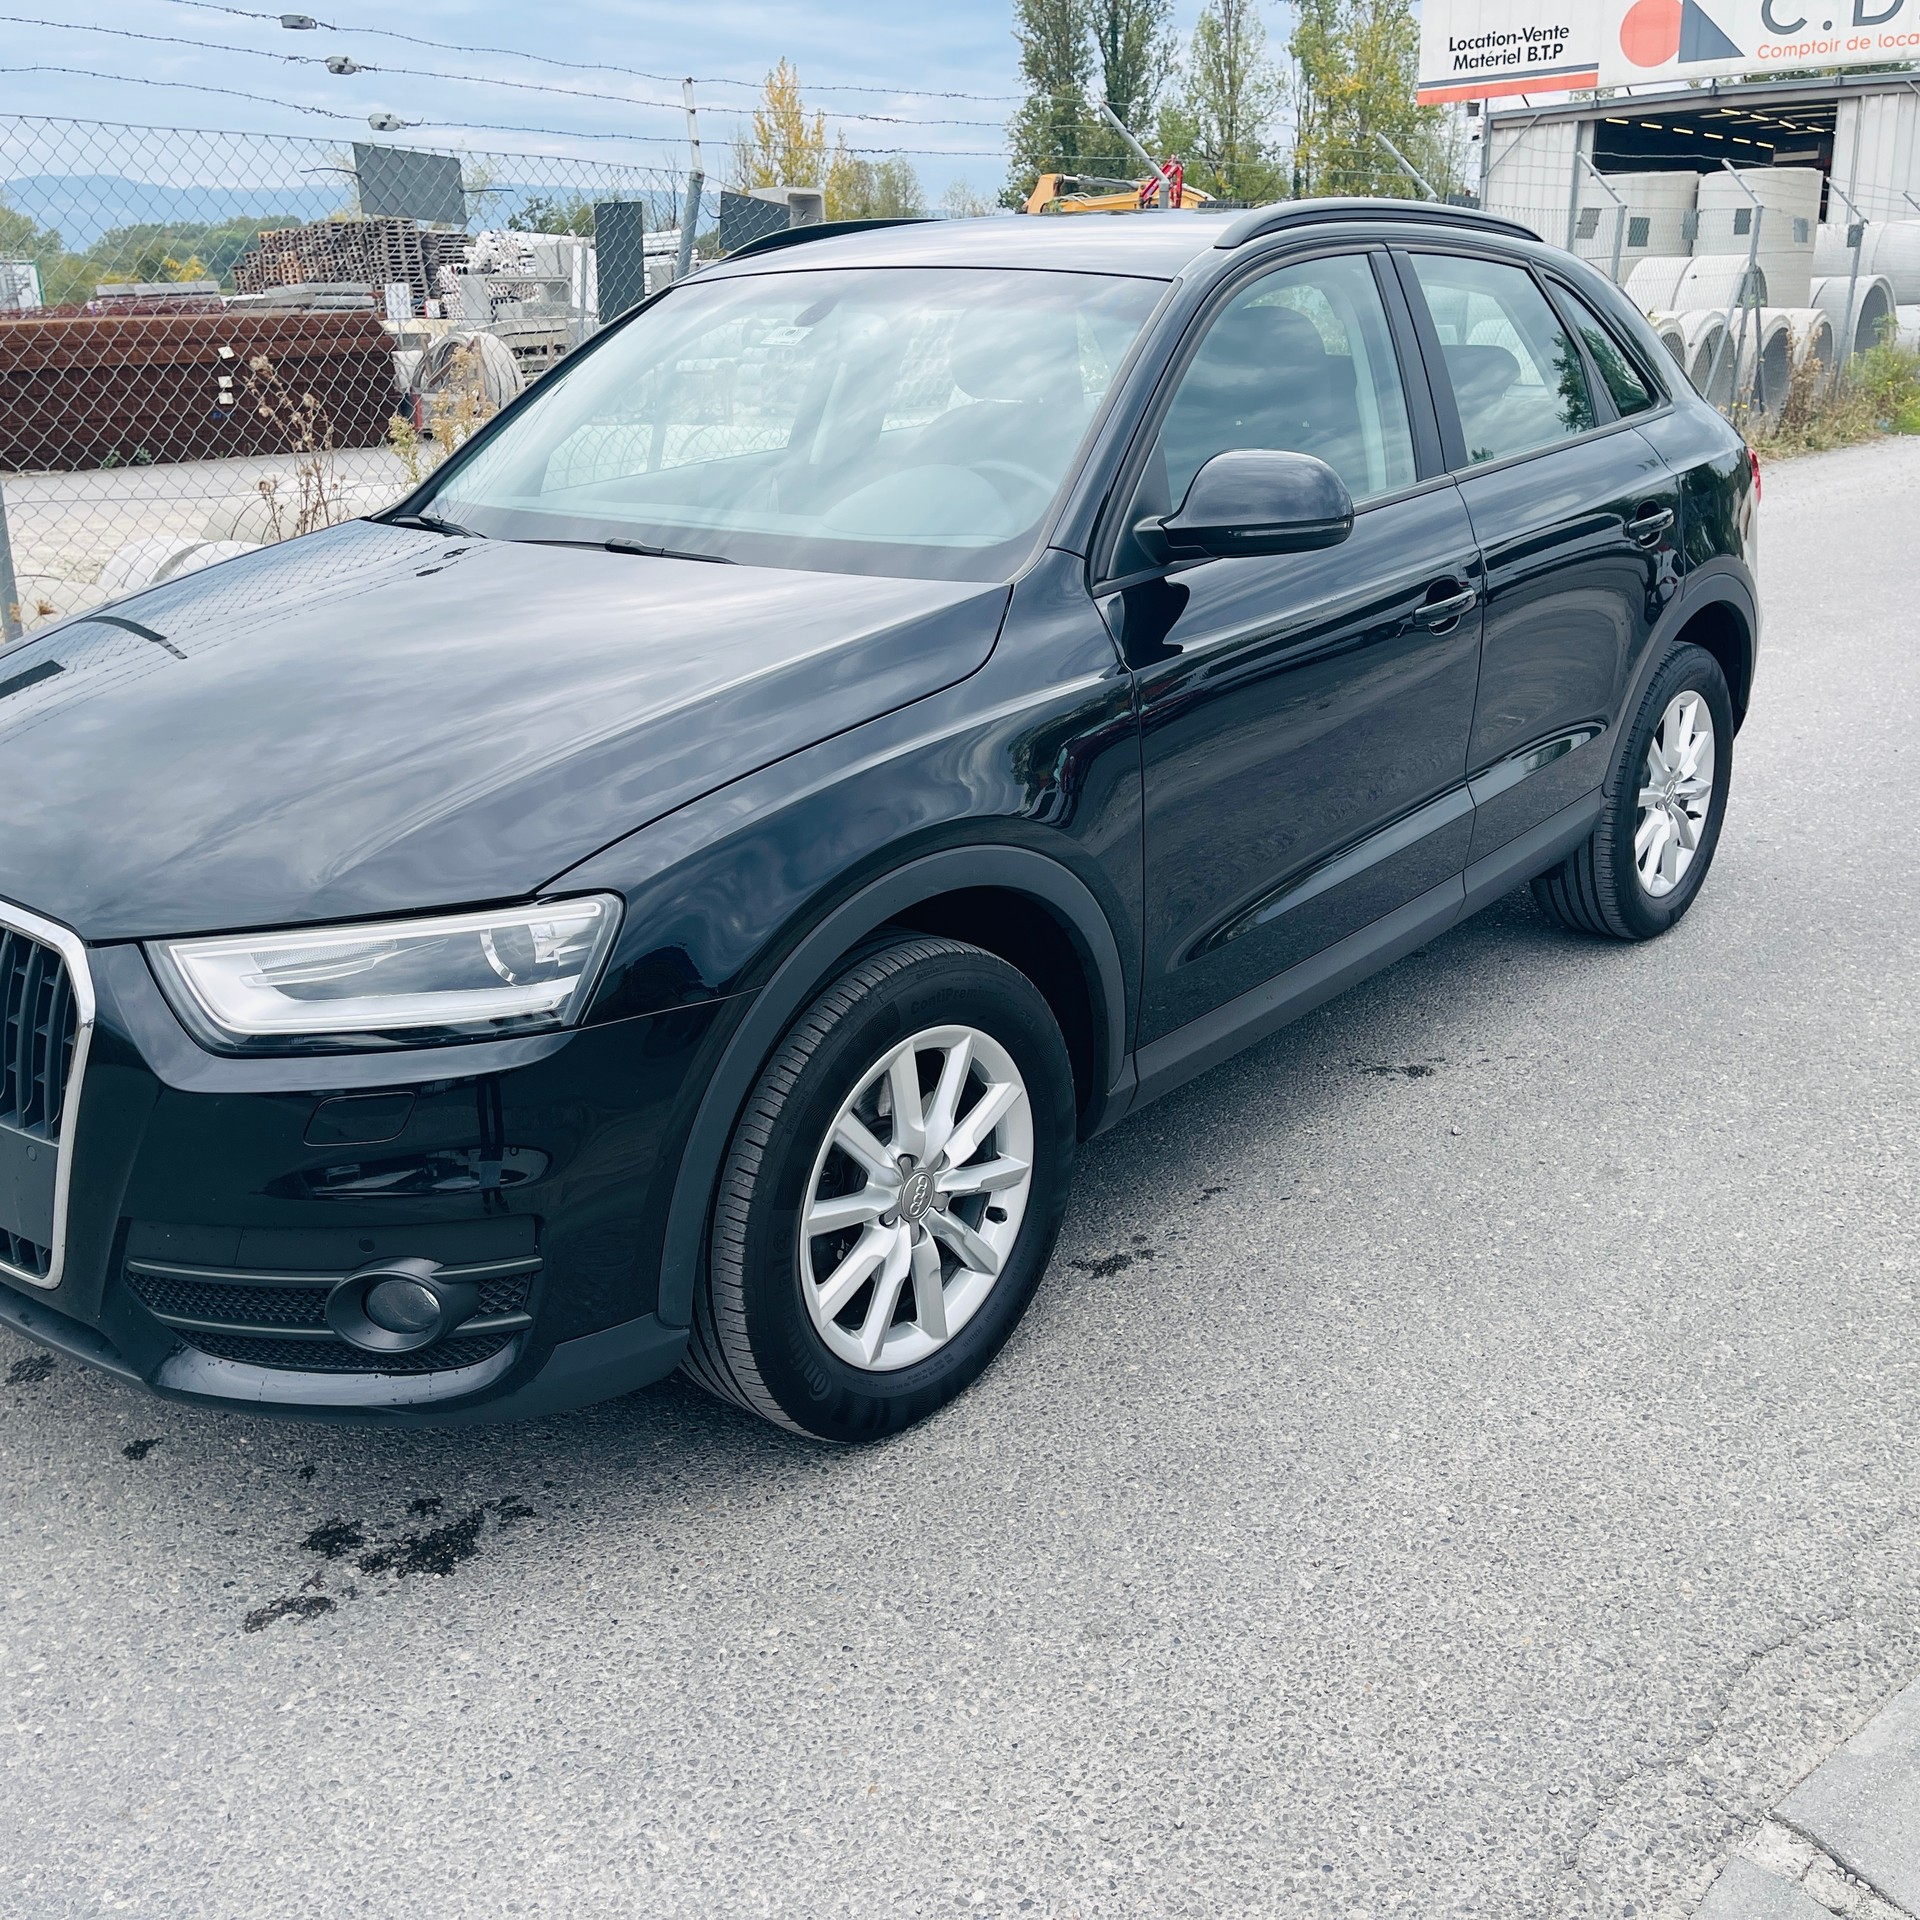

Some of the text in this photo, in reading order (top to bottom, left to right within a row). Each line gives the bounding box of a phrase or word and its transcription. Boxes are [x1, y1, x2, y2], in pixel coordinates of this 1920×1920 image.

[1449, 25, 1570, 52] Location-Vente
[1757, 33, 1920, 59] Comptoir de loca
[1453, 43, 1564, 70] Matériel B.T.P
